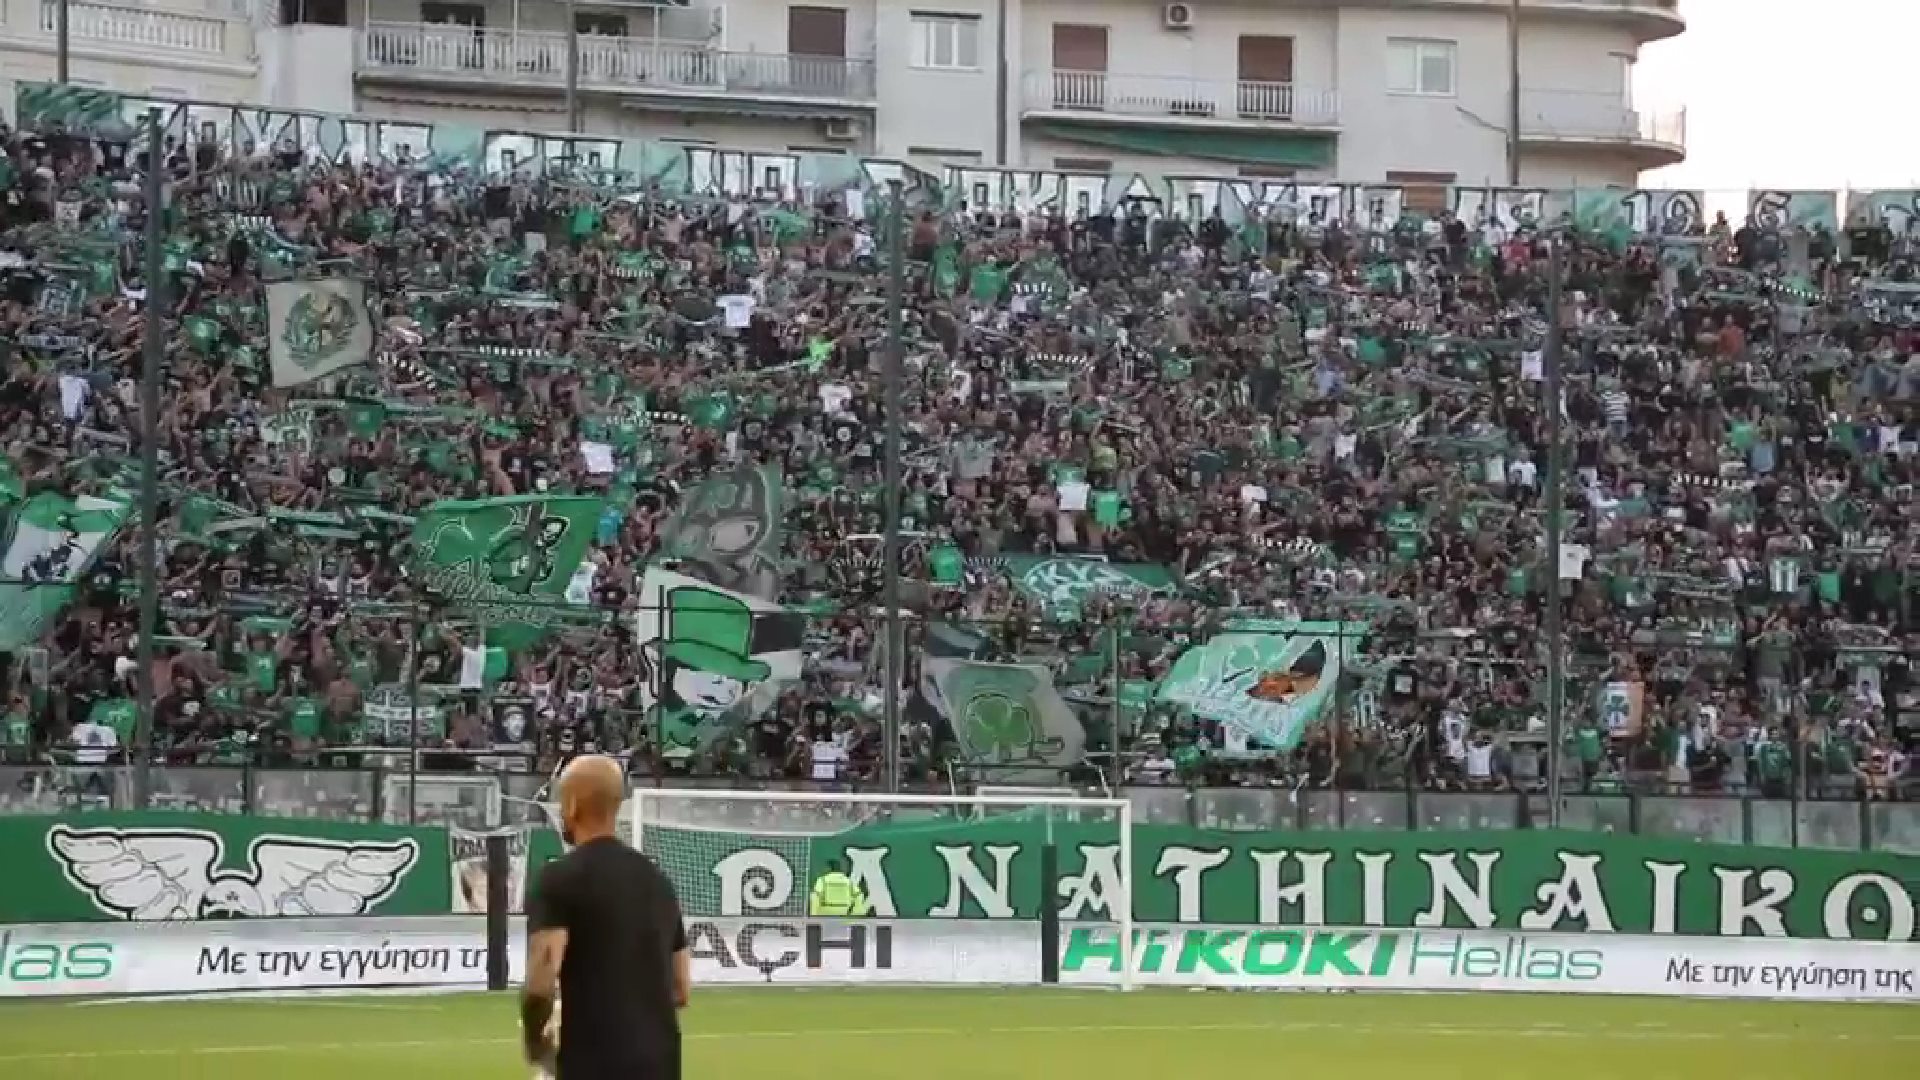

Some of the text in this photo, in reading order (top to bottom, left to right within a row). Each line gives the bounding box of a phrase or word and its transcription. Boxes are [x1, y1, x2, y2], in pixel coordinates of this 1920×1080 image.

[197, 946, 247, 976] Με
[258, 949, 311, 979] την
[320, 941, 449, 980] εγγύηση
[1408, 933, 1603, 980] Hellas
[1665, 956, 1913, 992] Με την εγγύηση της
